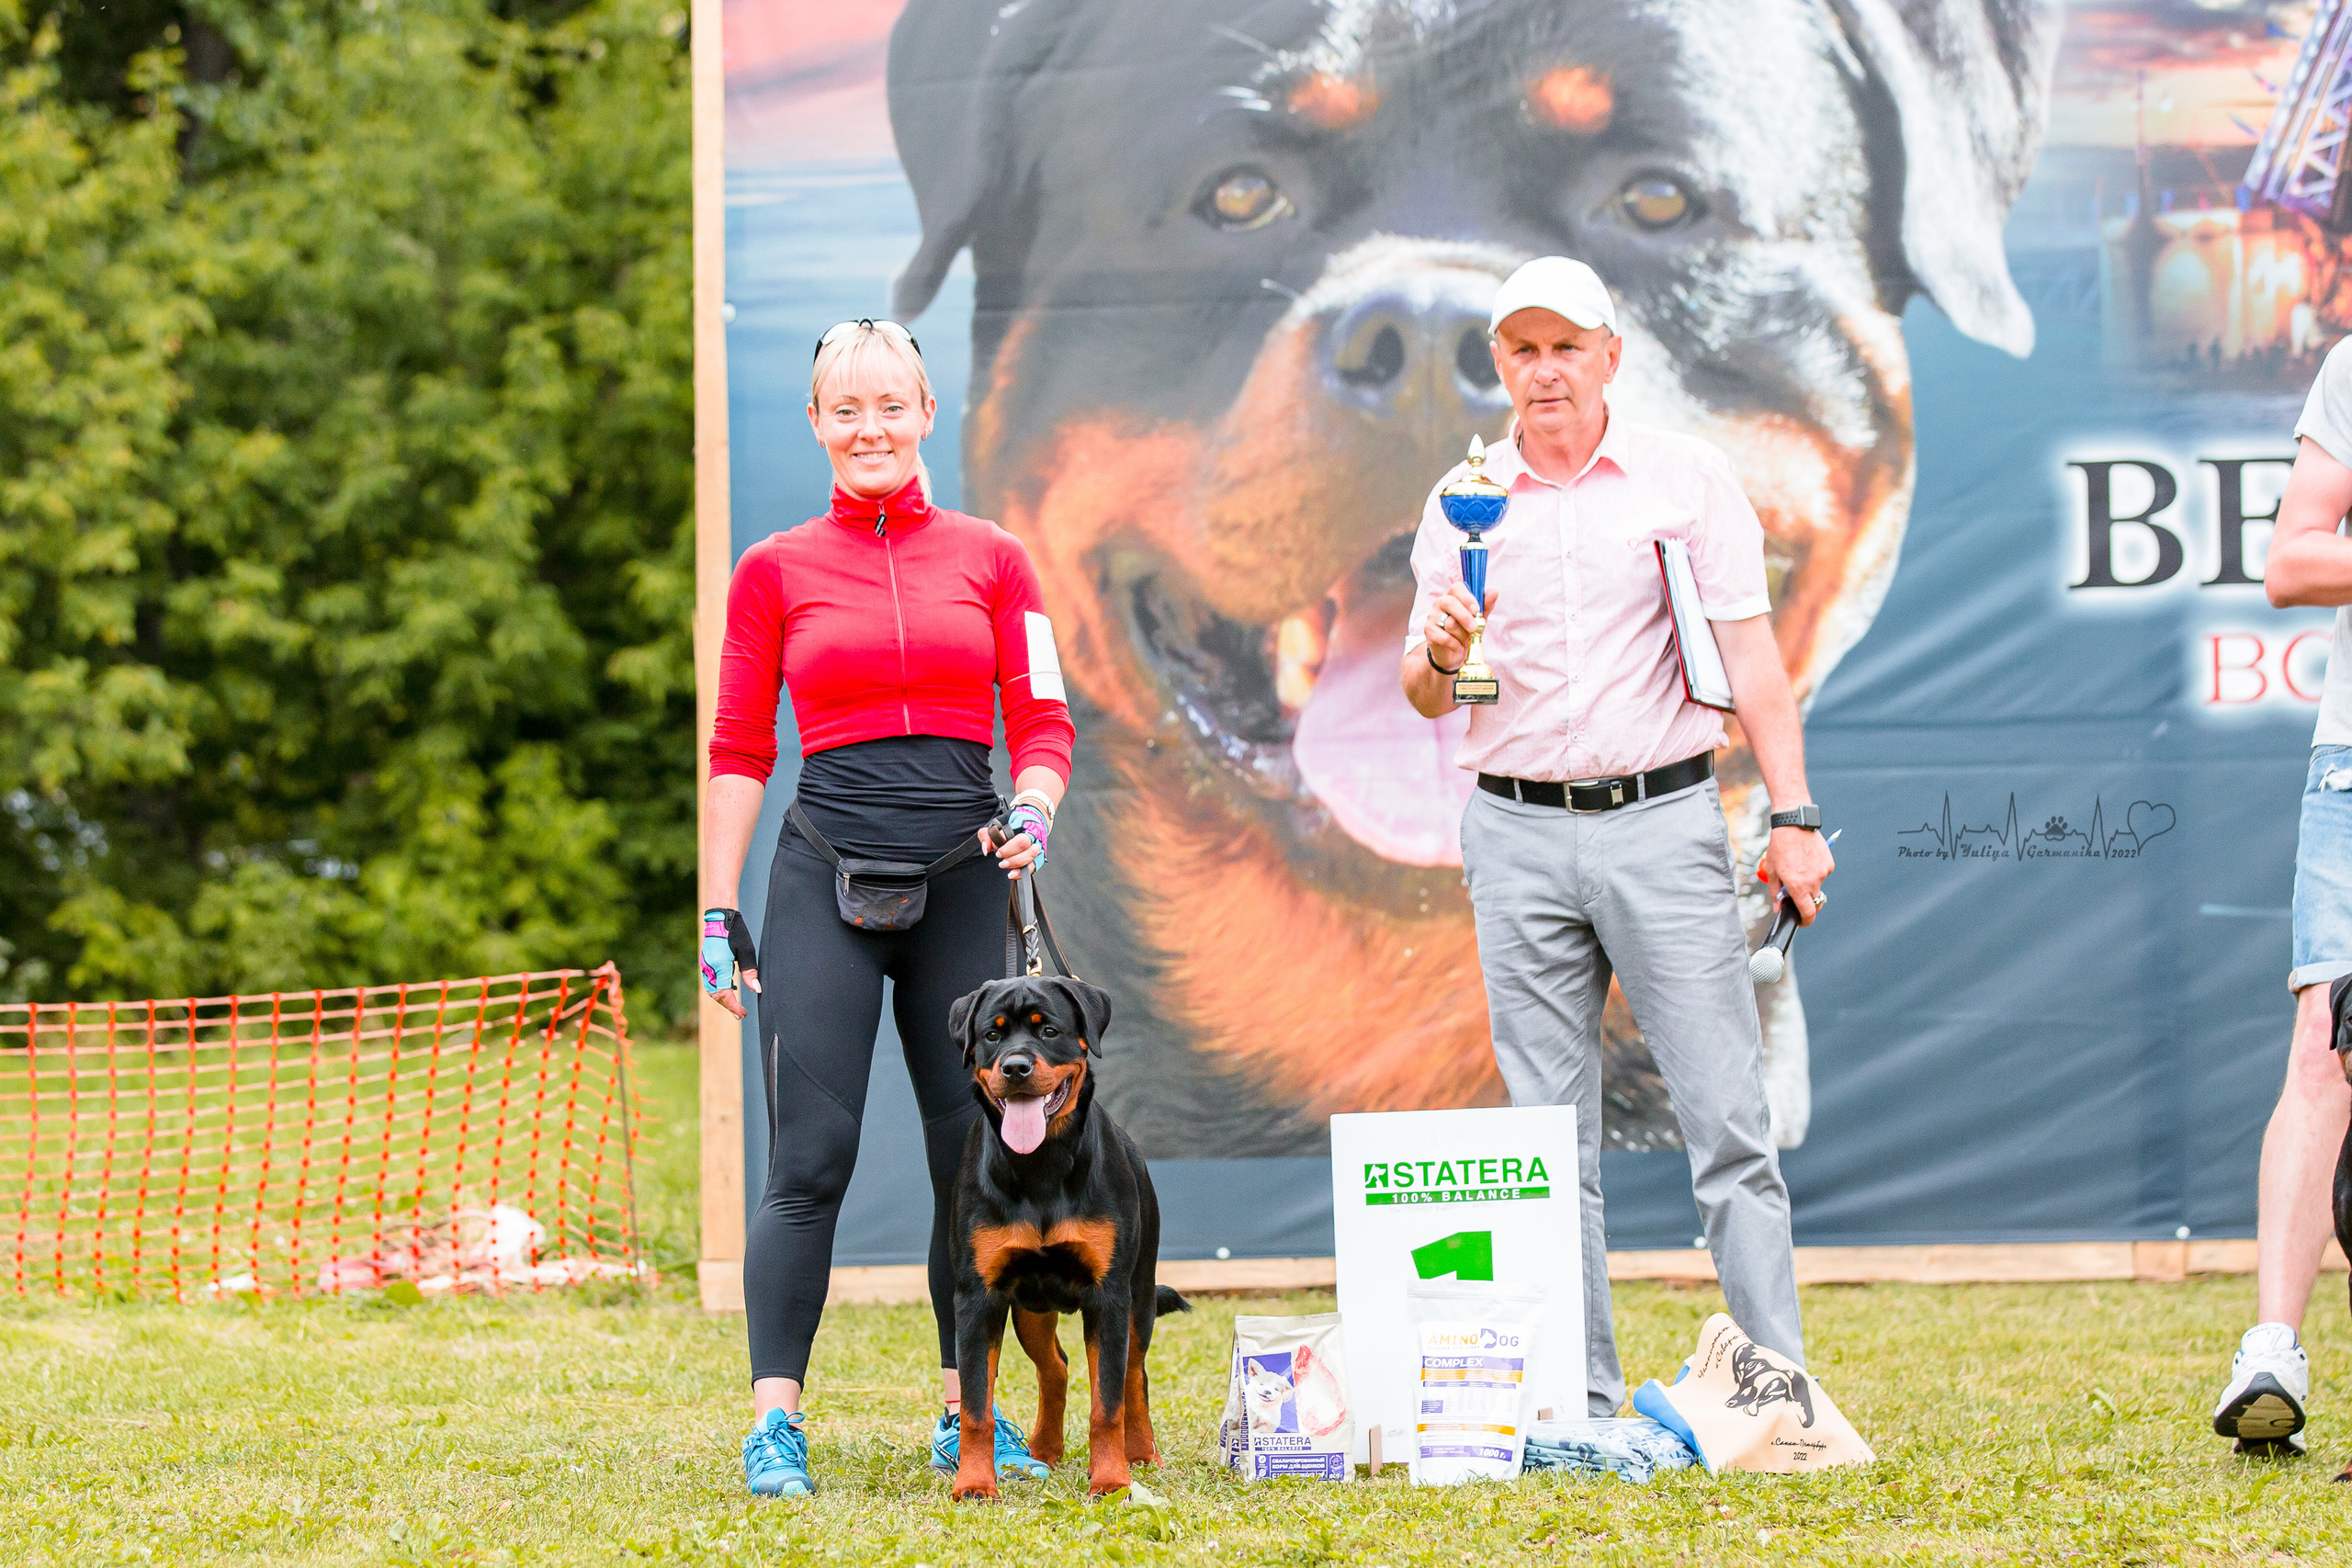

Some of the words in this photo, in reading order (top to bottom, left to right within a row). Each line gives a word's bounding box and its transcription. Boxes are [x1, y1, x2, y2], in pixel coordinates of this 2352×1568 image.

[1393, 1156, 1550, 1188] STATERA
[1392, 1192, 1433, 1203] 100%
[1442, 1189, 1521, 1201] BALANCE
[1424, 1358, 1484, 1368] COMPLEX
[1262, 1437, 1312, 1446] STATERA
[1479, 1448, 1499, 1458] 1000
[1793, 1451, 1807, 1461] 2022
